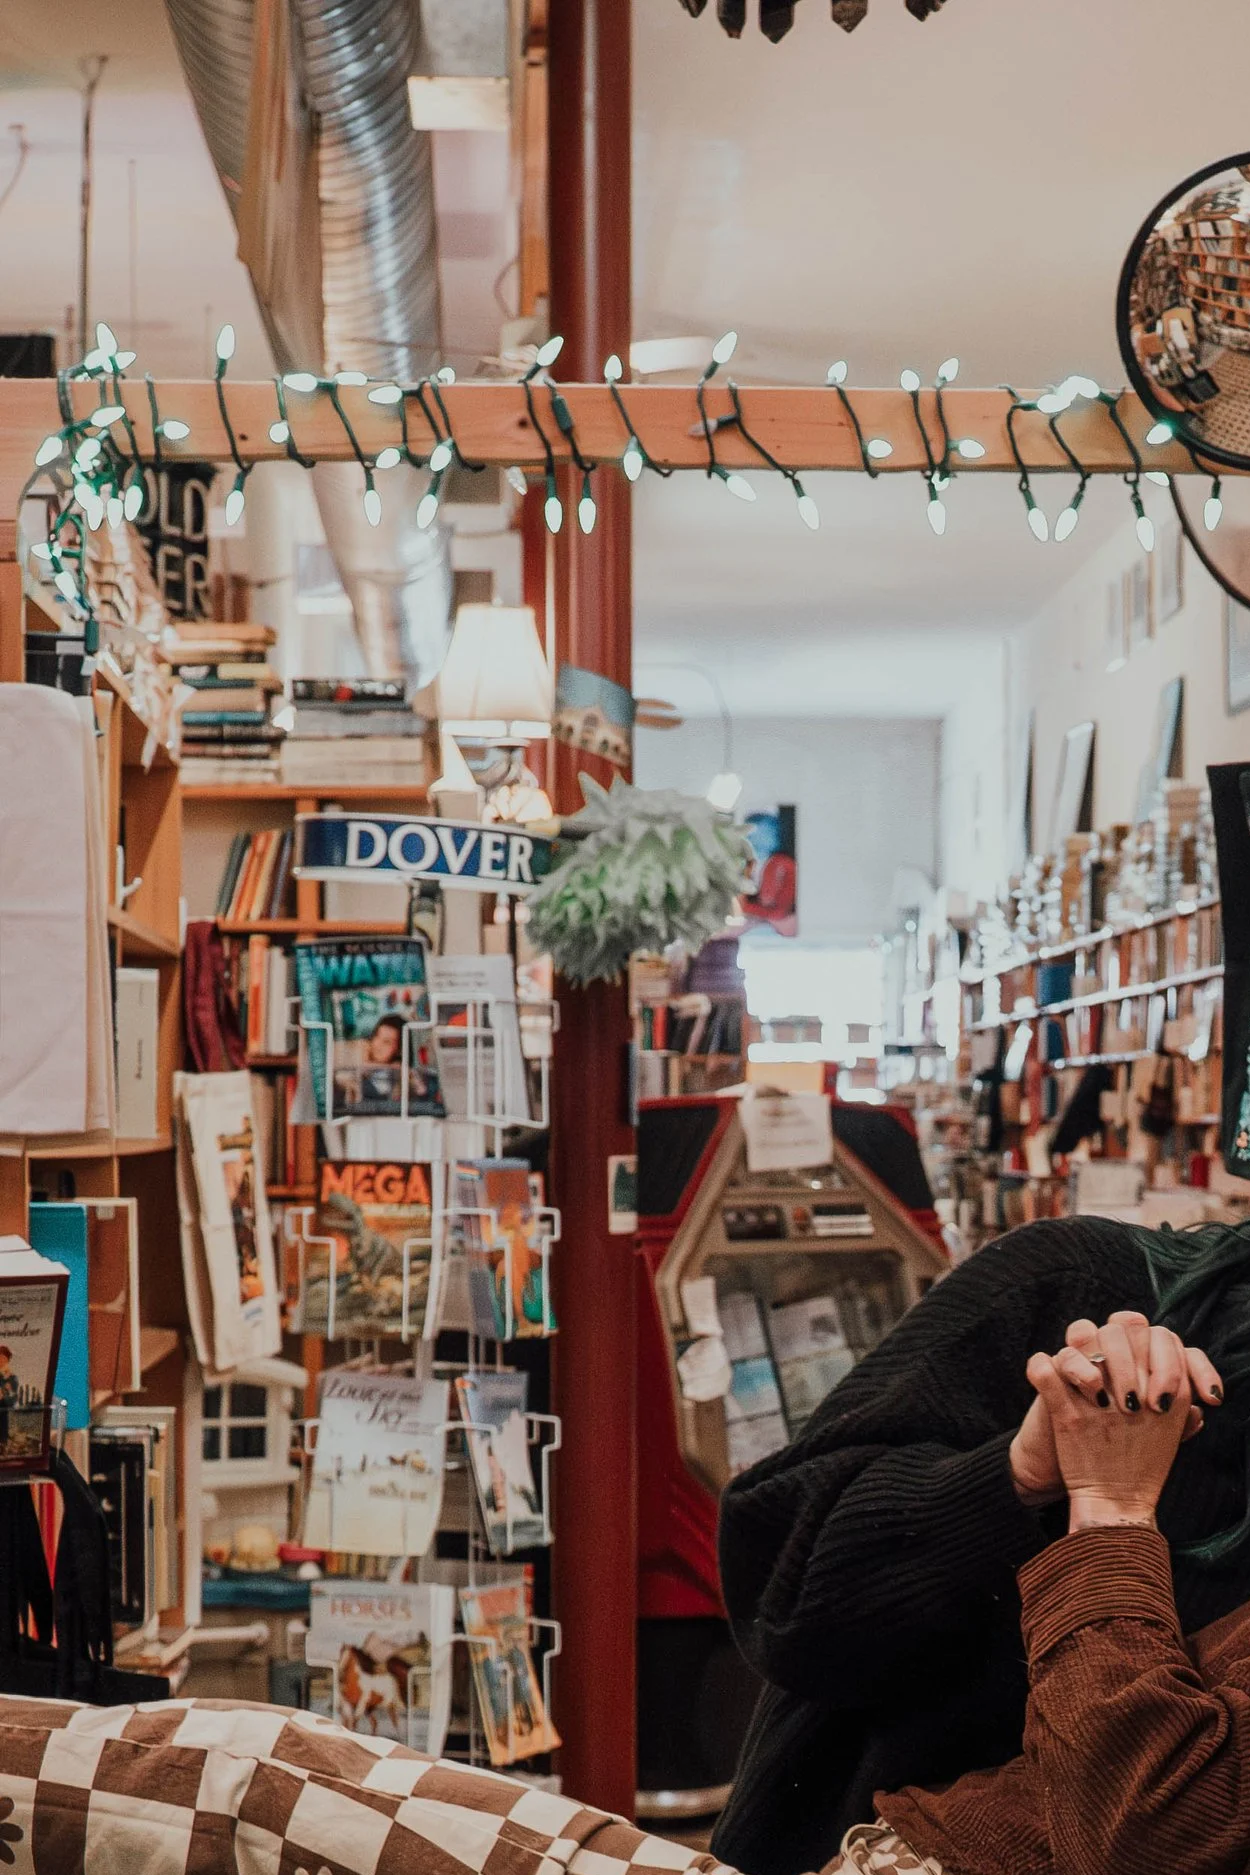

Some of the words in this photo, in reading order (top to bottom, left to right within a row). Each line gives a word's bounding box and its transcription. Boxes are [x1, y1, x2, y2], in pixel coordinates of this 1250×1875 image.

[344, 820, 535, 884] DOVER
[320, 1162, 431, 1204] MEGA
[330, 1600, 413, 1620] HORSES
